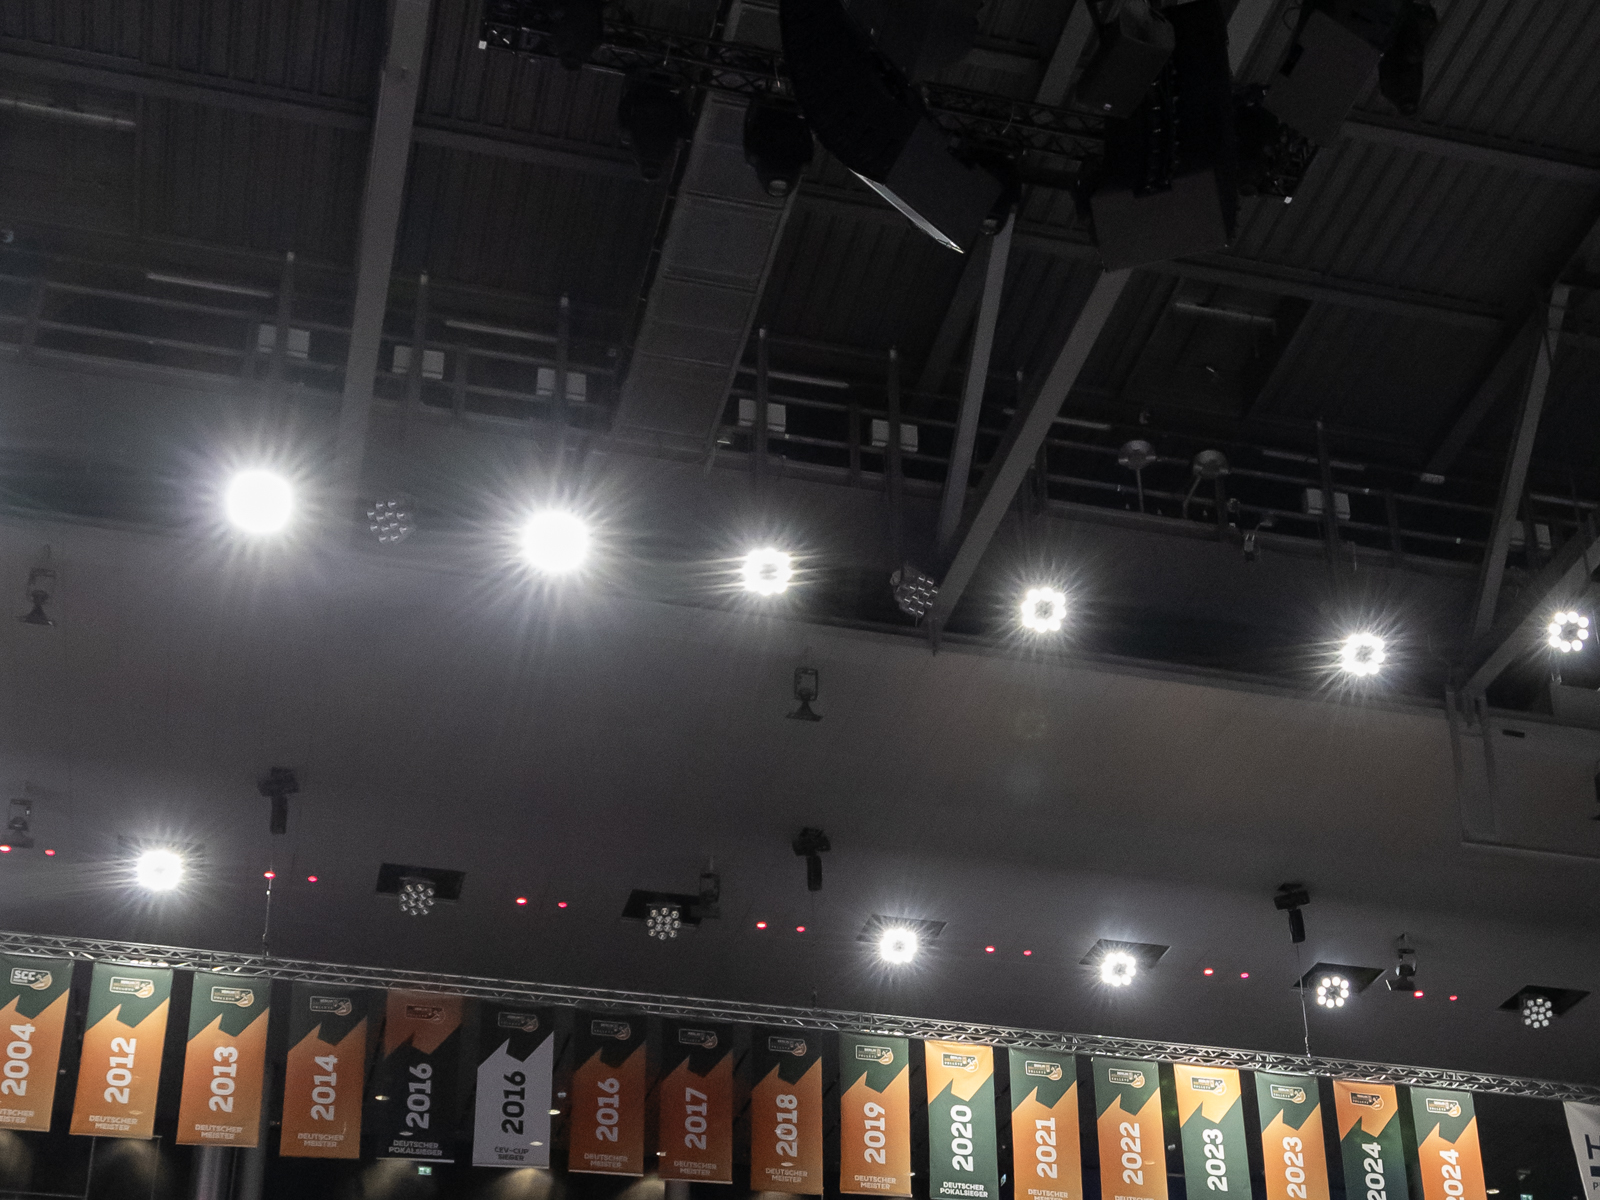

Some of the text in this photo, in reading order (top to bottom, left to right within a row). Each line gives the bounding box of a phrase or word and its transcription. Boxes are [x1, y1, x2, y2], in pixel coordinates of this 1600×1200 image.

[0, 1023, 36, 1097] 2004
[104, 1036, 137, 1104] 2012
[208, 1046, 238, 1112] 2013
[310, 1054, 339, 1122] 2014
[405, 1062, 433, 1130] 2016
[501, 1070, 526, 1136] 2016
[595, 1078, 620, 1142] 2016
[89, 1114, 138, 1124] DEUTSCHER
[684, 1087, 708, 1150] 2017
[95, 1122, 130, 1131] MEISTER
[195, 1124, 244, 1134] DEUTSCHER
[775, 1094, 798, 1158] 2018
[201, 1131, 236, 1140] MEISTER
[297, 1132, 345, 1142] DEUTSCHER
[864, 1102, 886, 1164] 2019
[950, 1104, 974, 1172] 2020
[304, 1140, 338, 1148] MEISTER
[392, 1140, 440, 1150] DEUTSCHER
[1035, 1117, 1058, 1180] 2021
[388, 1146, 443, 1156] POKALSIEGER
[1119, 1122, 1144, 1186] 2022
[498, 1154, 524, 1162] SIEGER
[584, 1152, 628, 1162] DEUTSCHER
[1202, 1128, 1229, 1192] 2023
[590, 1160, 622, 1168] MEISTER
[674, 1160, 718, 1170] DEUTSCHER
[1282, 1136, 1308, 1200] 2023
[765, 1168, 808, 1178] DEUTSCHER
[772, 1174, 802, 1184] MEISTER
[854, 1174, 897, 1184] DEUTSCHER
[860, 1182, 892, 1190] MEISTER
[942, 1181, 985, 1192] DEUTSCHER
[940, 1188, 988, 1198] POKALSIEGER
[1028, 1188, 1069, 1198] DEUTSCHER
